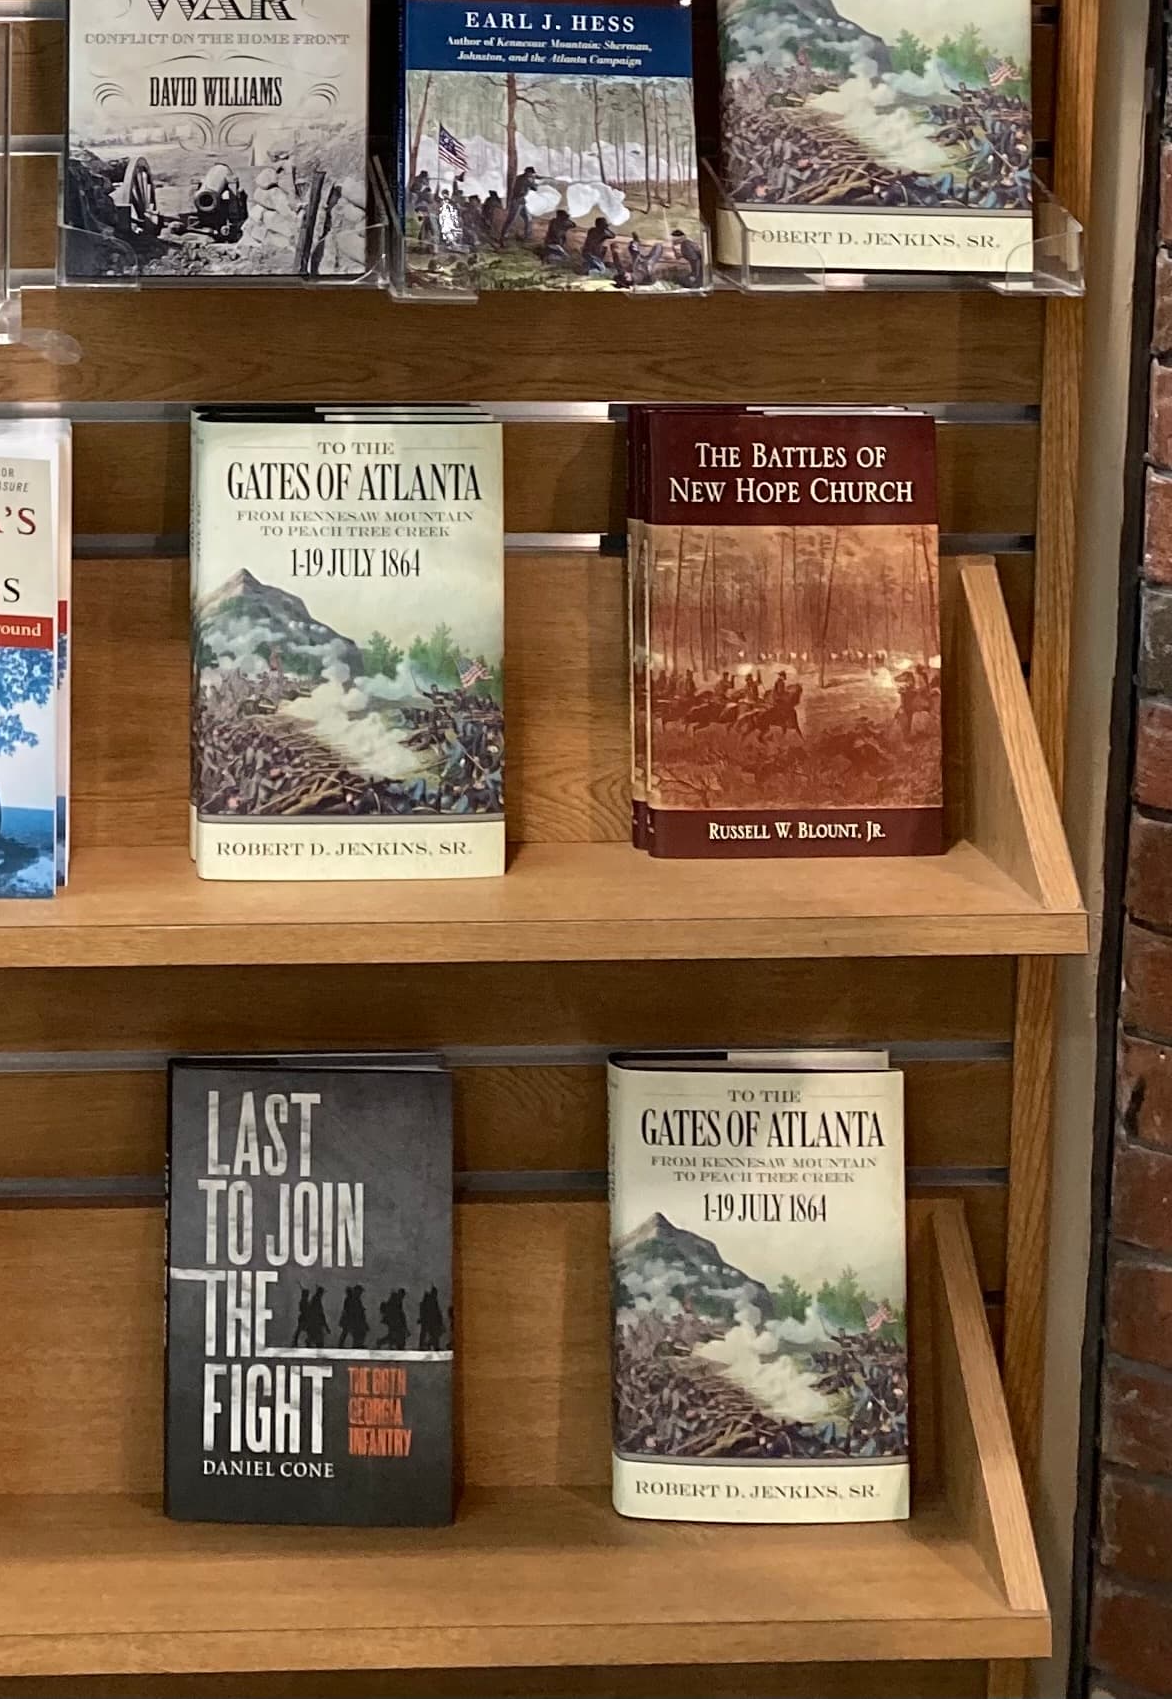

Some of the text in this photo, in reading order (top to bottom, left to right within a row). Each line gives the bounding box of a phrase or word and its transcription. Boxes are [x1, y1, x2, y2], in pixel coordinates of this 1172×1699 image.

[149, 77, 282, 107] DAVID WILLIAMS
[695, 442, 888, 468] THE BATTLES OF
[228, 462, 482, 501] GATES OF ATLANTA
[669, 478, 913, 503] NEW HOPE CHURCH
[709, 821, 885, 842] RUSSELL W. BLOUNT, JR.
[207, 1091, 321, 1176] LAST
[641, 1109, 885, 1148] GATES OF ATLANTA
[198, 1179, 364, 1268] TO JOIN
[204, 1270, 279, 1357] THE
[203, 1364, 332, 1454] FIGHT
[203, 1460, 335, 1479] DANIEL CONE
